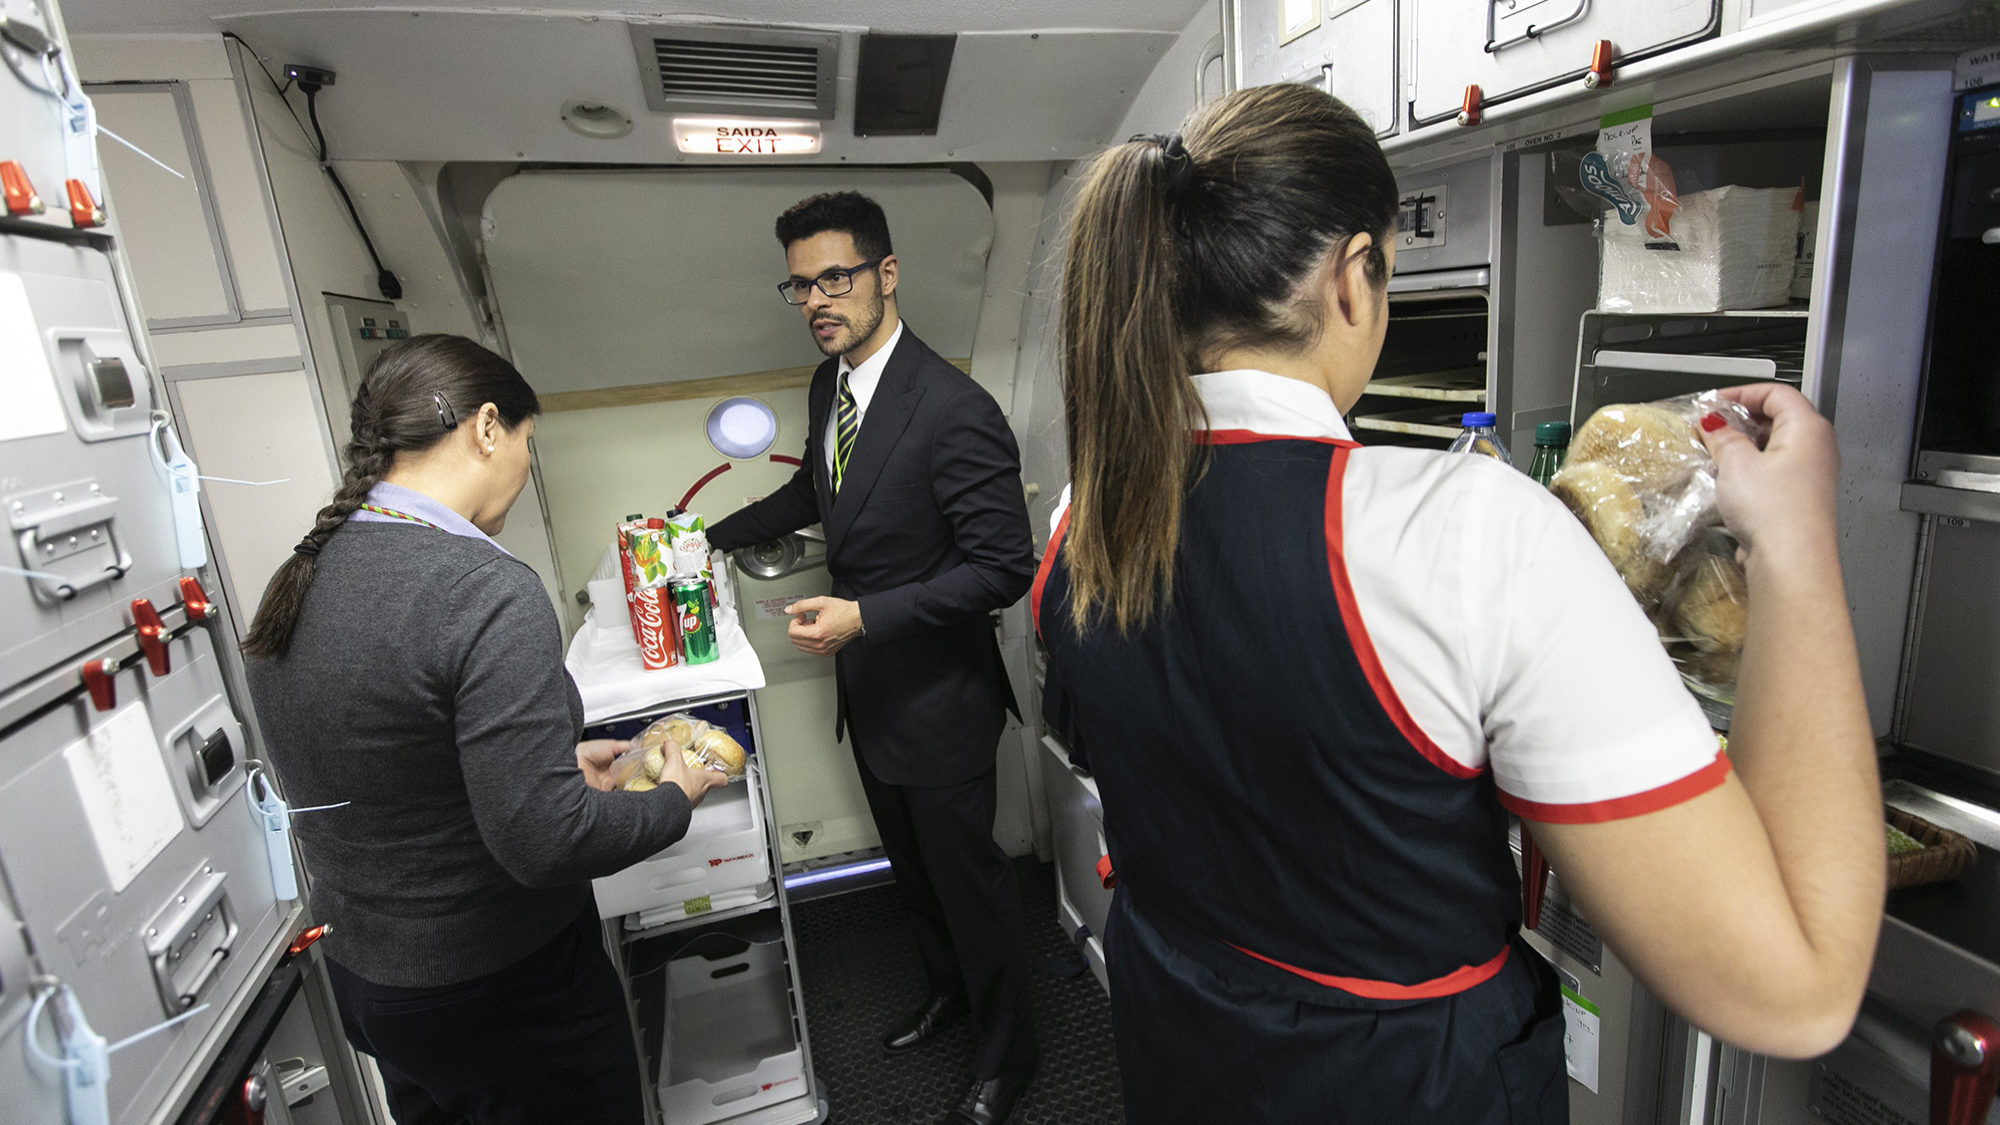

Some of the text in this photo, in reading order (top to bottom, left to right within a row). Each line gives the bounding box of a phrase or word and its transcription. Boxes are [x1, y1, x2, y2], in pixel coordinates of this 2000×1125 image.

[717, 127, 777, 137] SAIDA
[716, 138, 782, 153] EXIT
[635, 588, 668, 668] Coca-Cola
